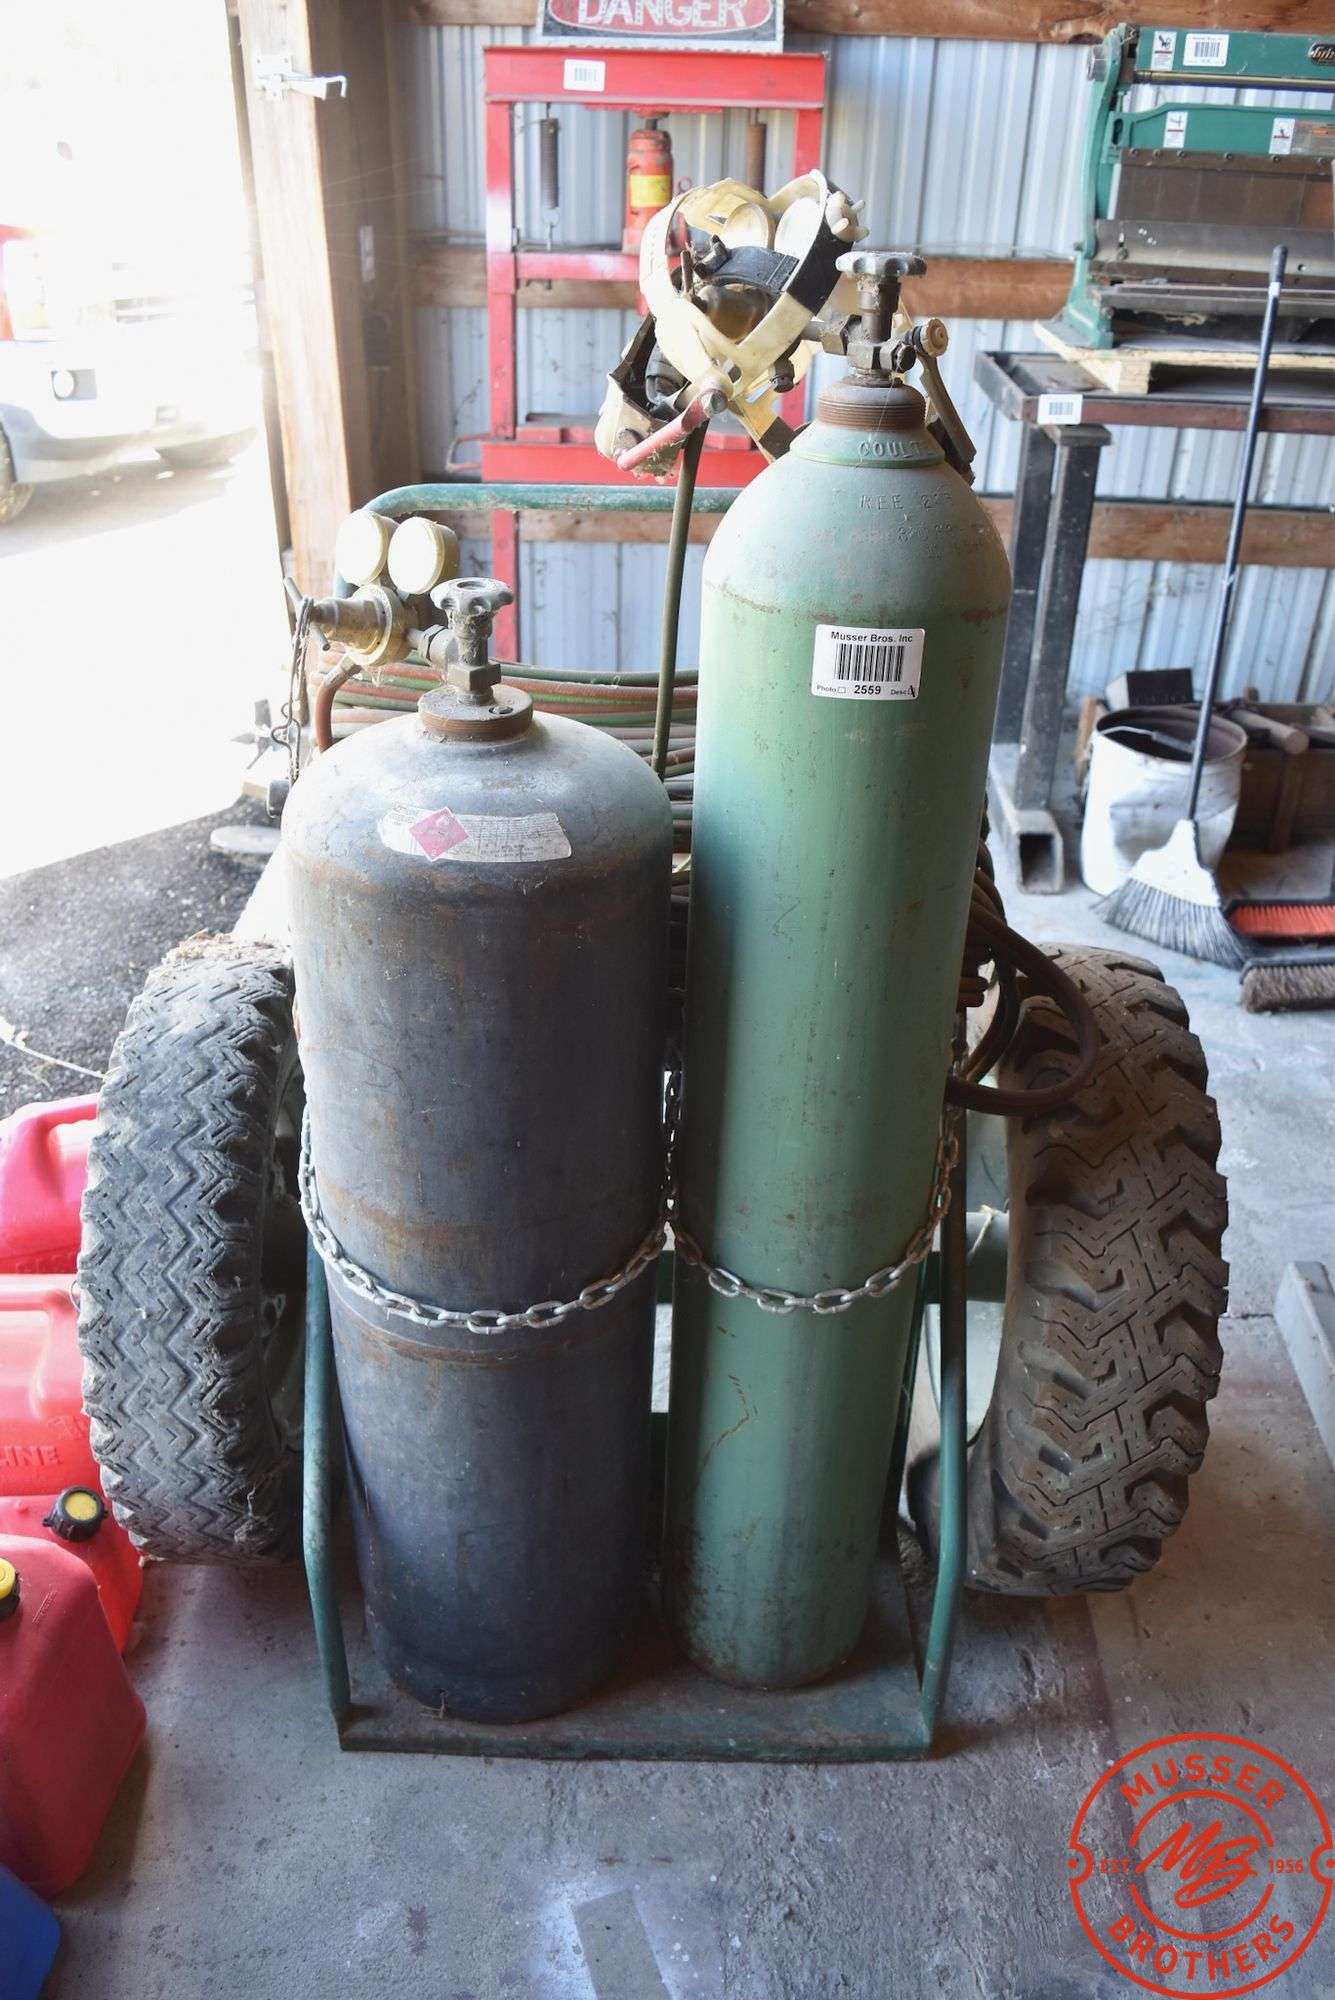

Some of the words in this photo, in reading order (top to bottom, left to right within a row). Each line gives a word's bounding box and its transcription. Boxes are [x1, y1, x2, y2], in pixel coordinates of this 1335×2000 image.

[577, 0, 748, 28] DANGER
[830, 631, 867, 642] Musser
[870, 634, 896, 643] Bros.
[898, 635, 913, 643] Inc
[853, 684, 882, 695] 2559
